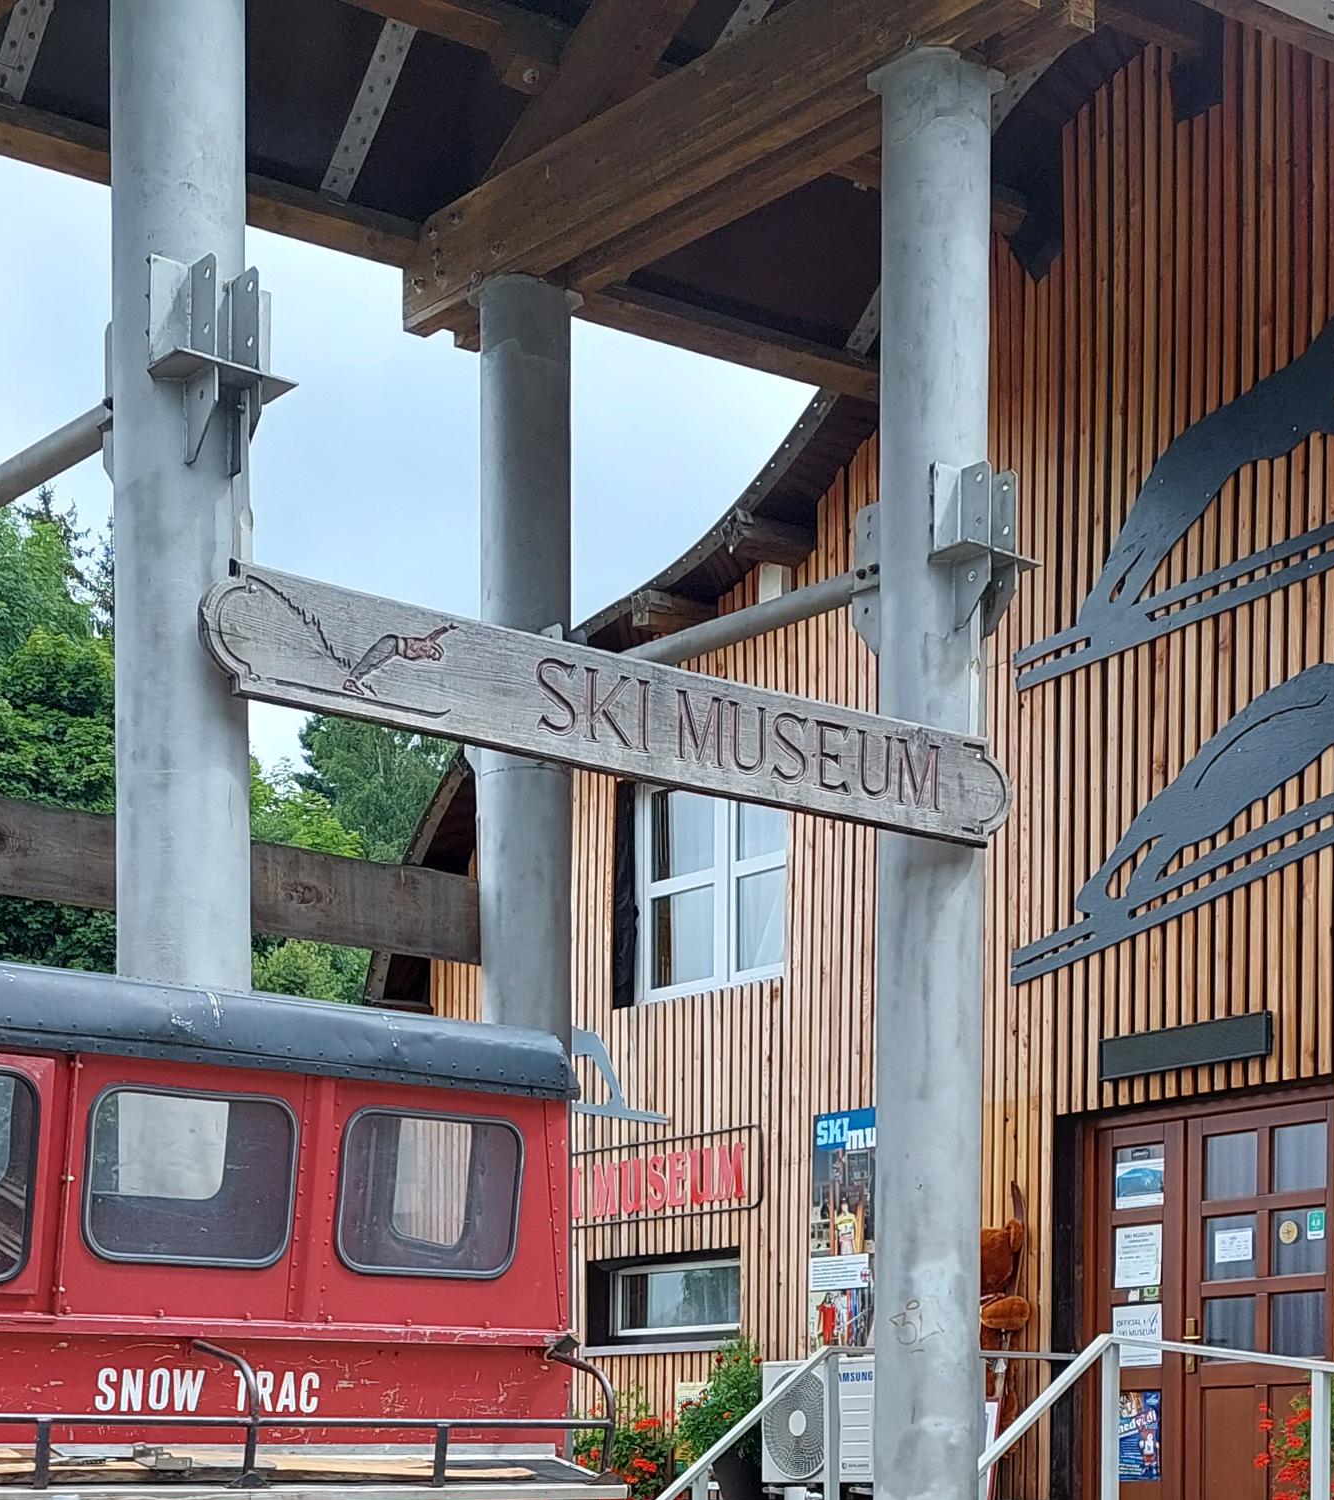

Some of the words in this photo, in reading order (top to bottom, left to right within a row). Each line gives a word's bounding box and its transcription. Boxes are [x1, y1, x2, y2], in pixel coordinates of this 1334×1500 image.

[535, 657, 651, 754] SKI
[675, 689, 943, 814] MUSEUM
[817, 1117, 849, 1145] SKI
[593, 1143, 746, 1217] MUSEUM
[94, 1367, 205, 1412] SNOW
[233, 1370, 320, 1414] TRAC
[839, 1371, 873, 1382] MSUNG
